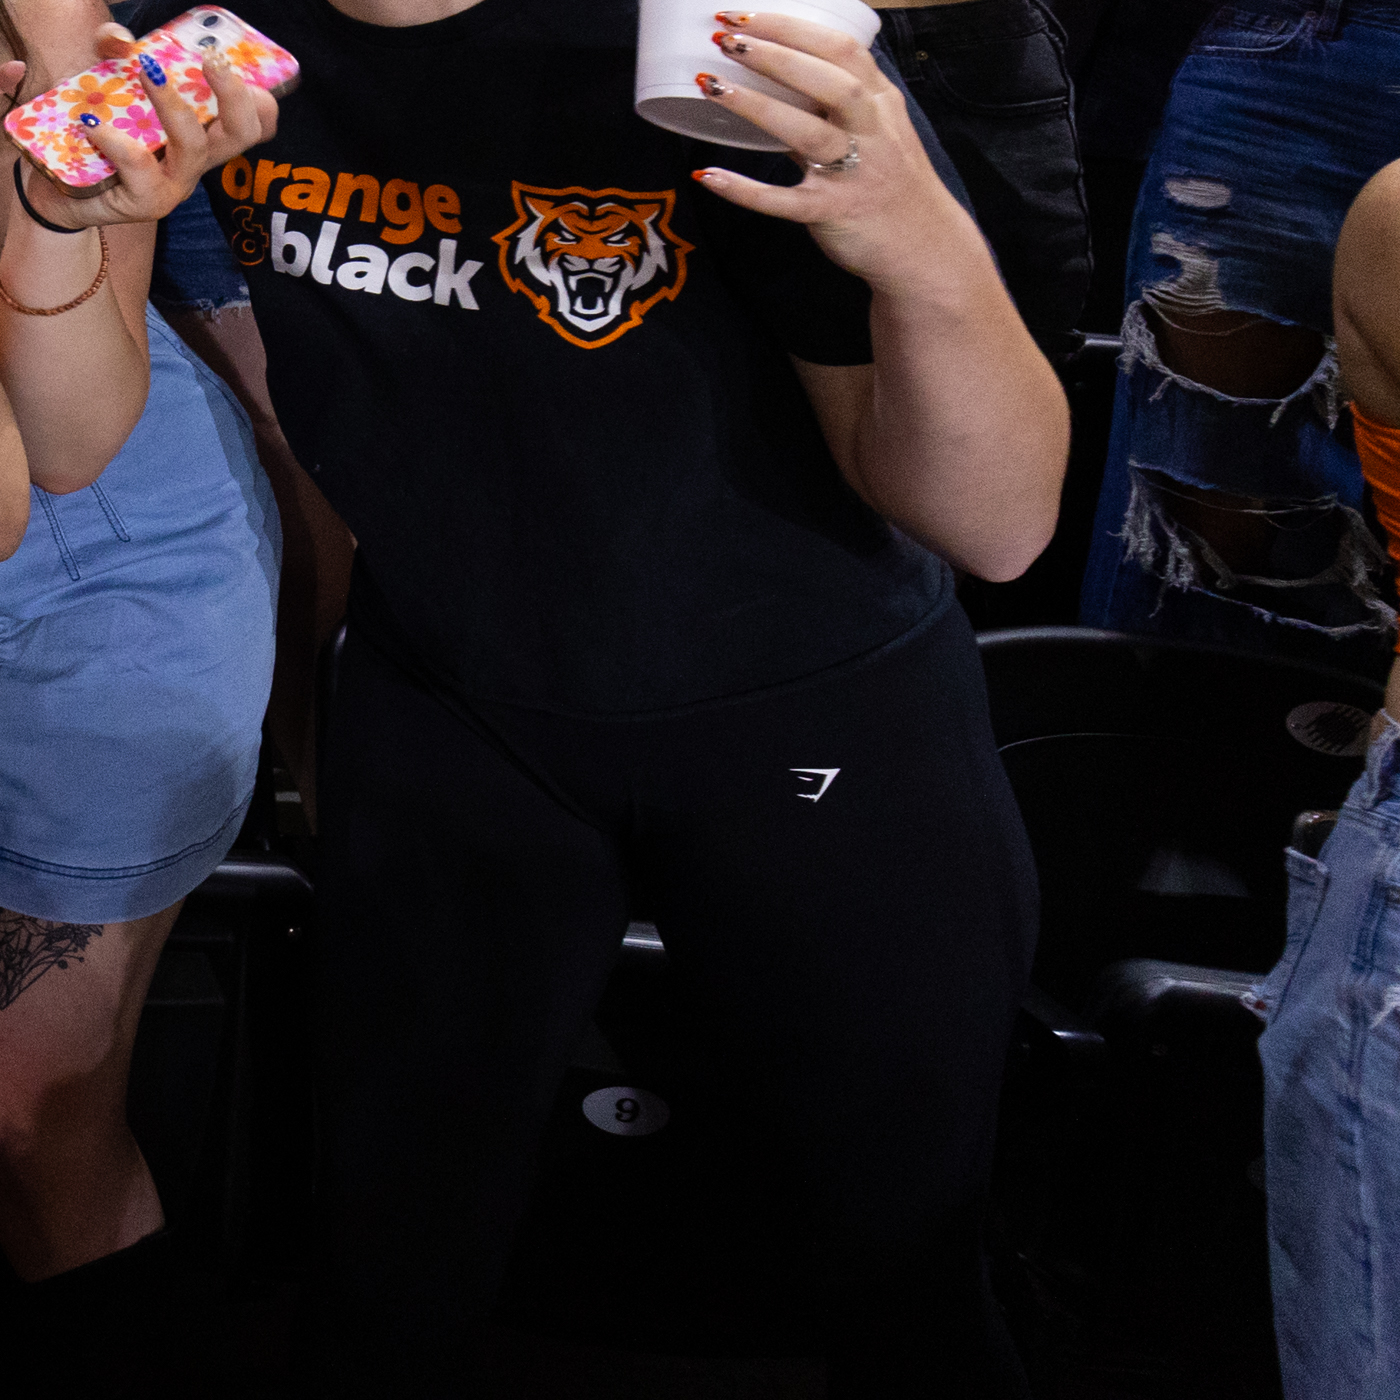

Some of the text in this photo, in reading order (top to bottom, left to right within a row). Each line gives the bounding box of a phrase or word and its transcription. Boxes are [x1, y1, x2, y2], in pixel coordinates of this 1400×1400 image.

[221, 154, 463, 245] orange
[230, 205, 485, 311] & black
[615, 1097, 640, 1123] 9
